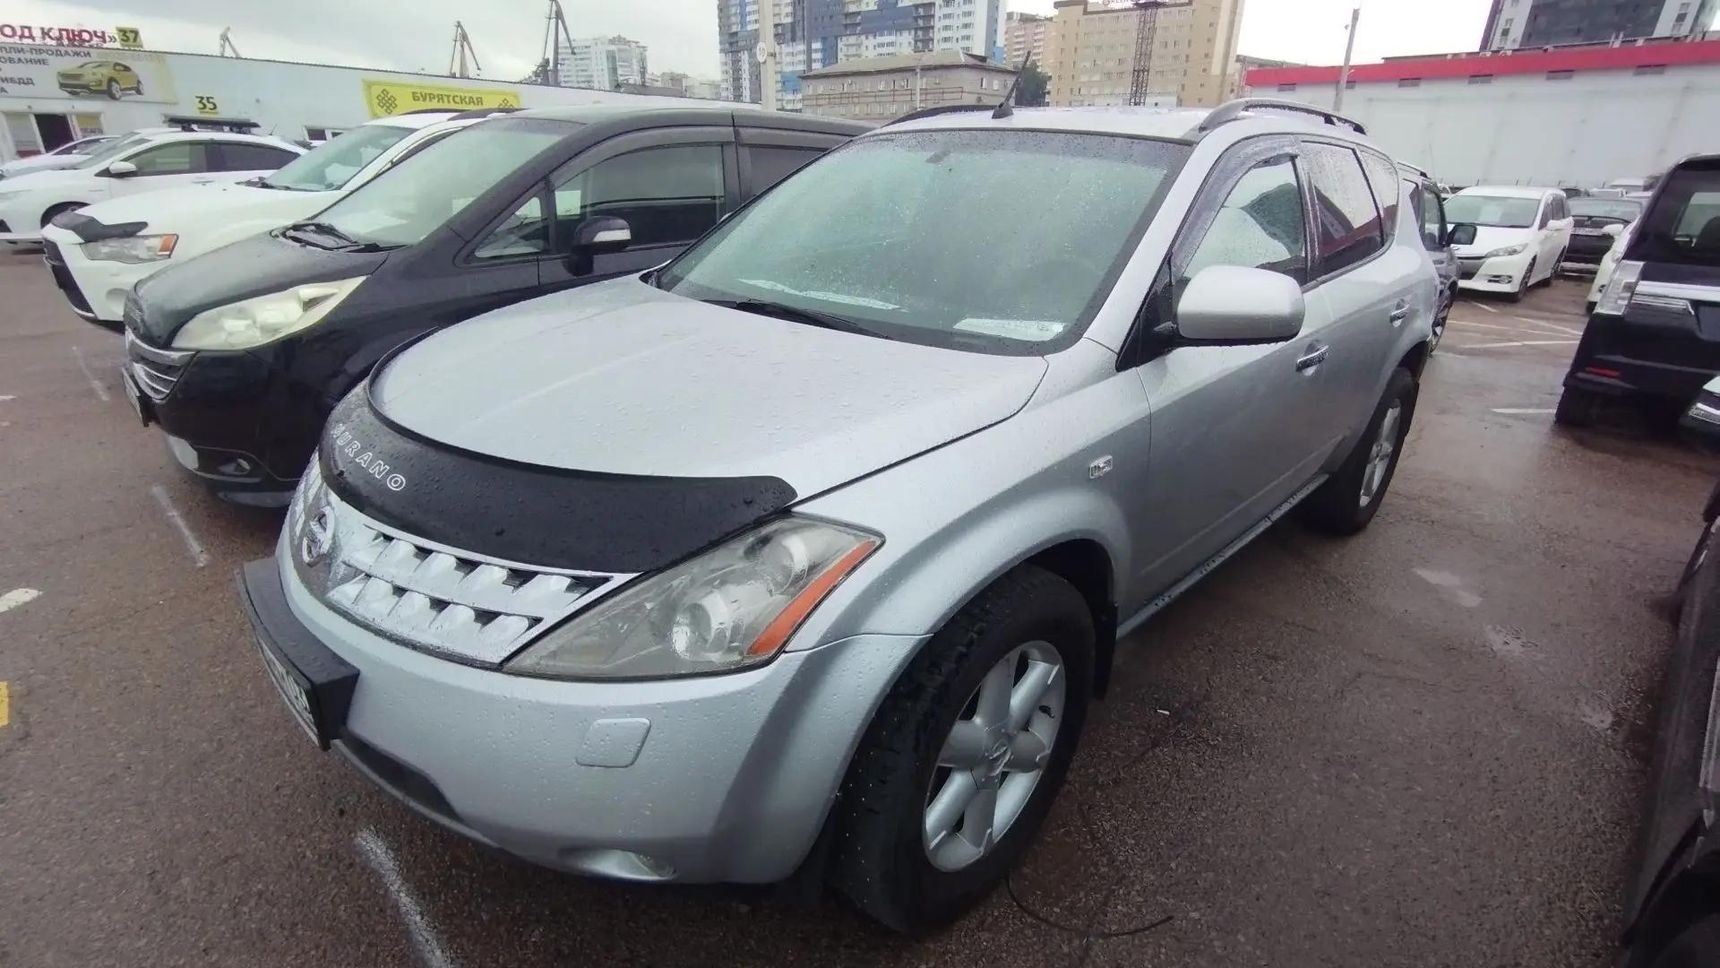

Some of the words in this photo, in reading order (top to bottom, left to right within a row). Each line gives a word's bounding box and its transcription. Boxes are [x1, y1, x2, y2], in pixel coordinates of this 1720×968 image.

[119, 29, 139, 43] 37
[195, 95, 217, 110] 35
[411, 91, 484, 106] БУРЯТСКАЯ
